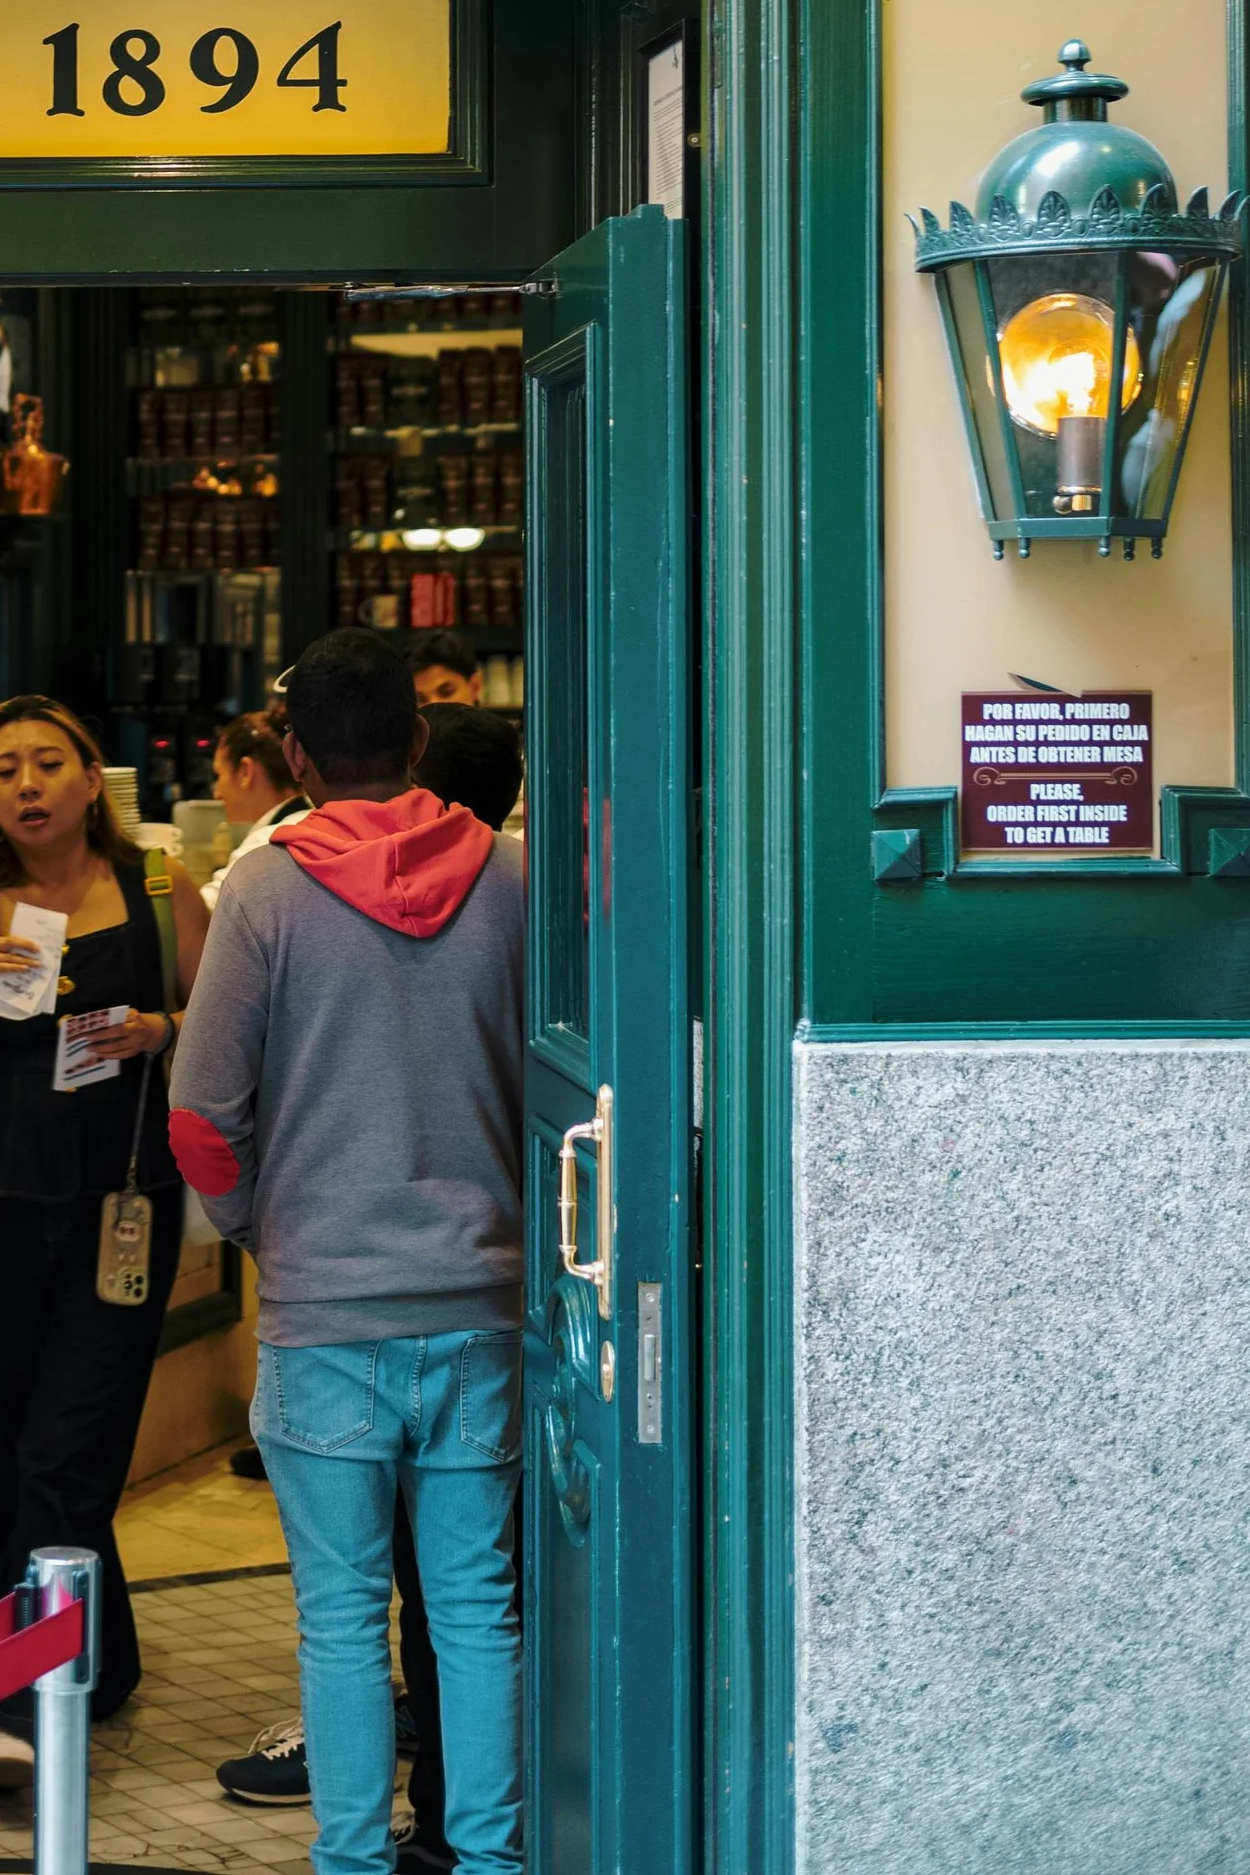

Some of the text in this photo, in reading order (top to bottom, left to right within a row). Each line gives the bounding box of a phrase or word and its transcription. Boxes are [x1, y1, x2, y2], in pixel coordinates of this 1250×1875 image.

[42, 20, 348, 117] 1894
[982, 703, 1130, 720] POR FAVOR, PRIMERO
[964, 725, 1149, 741] HAGAN SU PEDIDO EN CAJA
[969, 746, 1144, 763] ANTES DE OBTENER MESA
[1030, 783, 1084, 801] PLEASE,
[986, 805, 1128, 822] ORDER FIRST INSIDE
[1004, 827, 1110, 844] TO GET A TABLE
